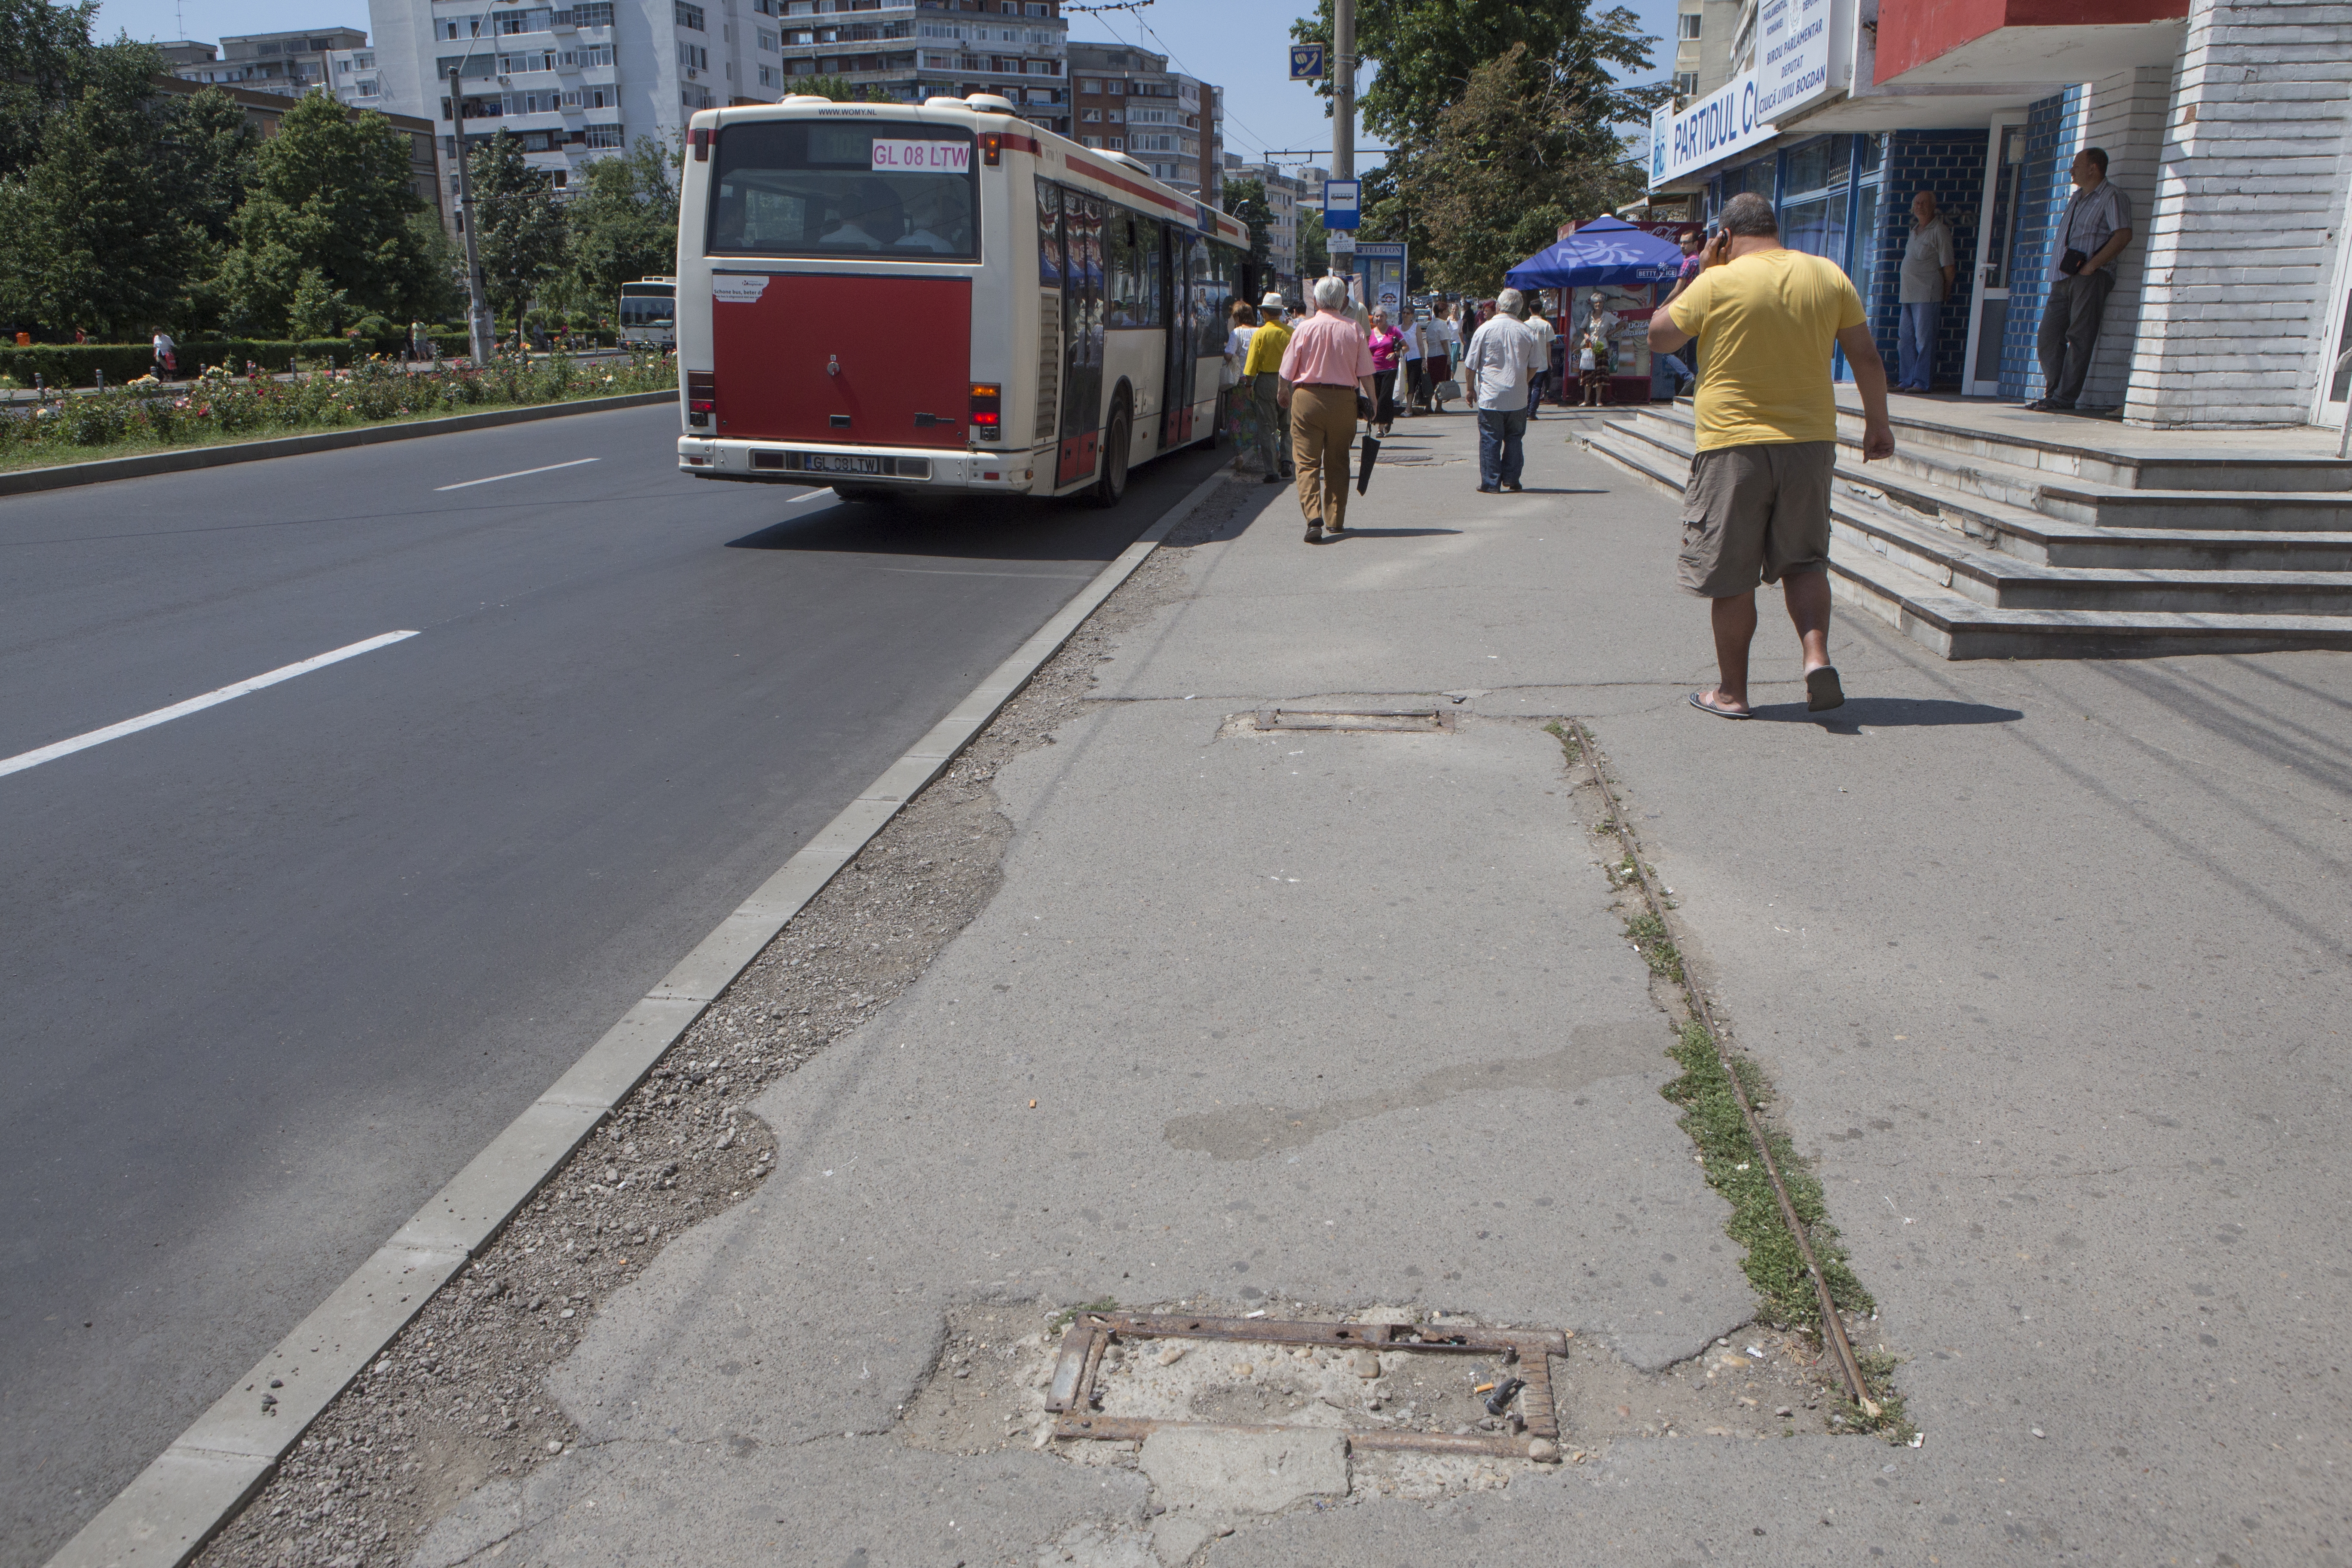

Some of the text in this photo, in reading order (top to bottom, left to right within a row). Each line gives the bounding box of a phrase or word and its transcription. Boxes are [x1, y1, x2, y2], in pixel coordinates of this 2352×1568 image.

[1764, 0, 1787, 23] PARLAMENTUL
[1767, 18, 1822, 65] BIROU PARLAMENTAR
[1781, 54, 1804, 79] DEPUTAT
[1778, 81, 1795, 104] LIVIU
[1796, 64, 1826, 95] BOGDAN
[1674, 92, 1737, 167] PARTIDUL
[873, 145, 969, 167] GL 08 LTW
[1654, 142, 1665, 175] PC
[814, 456, 830, 469] GL
